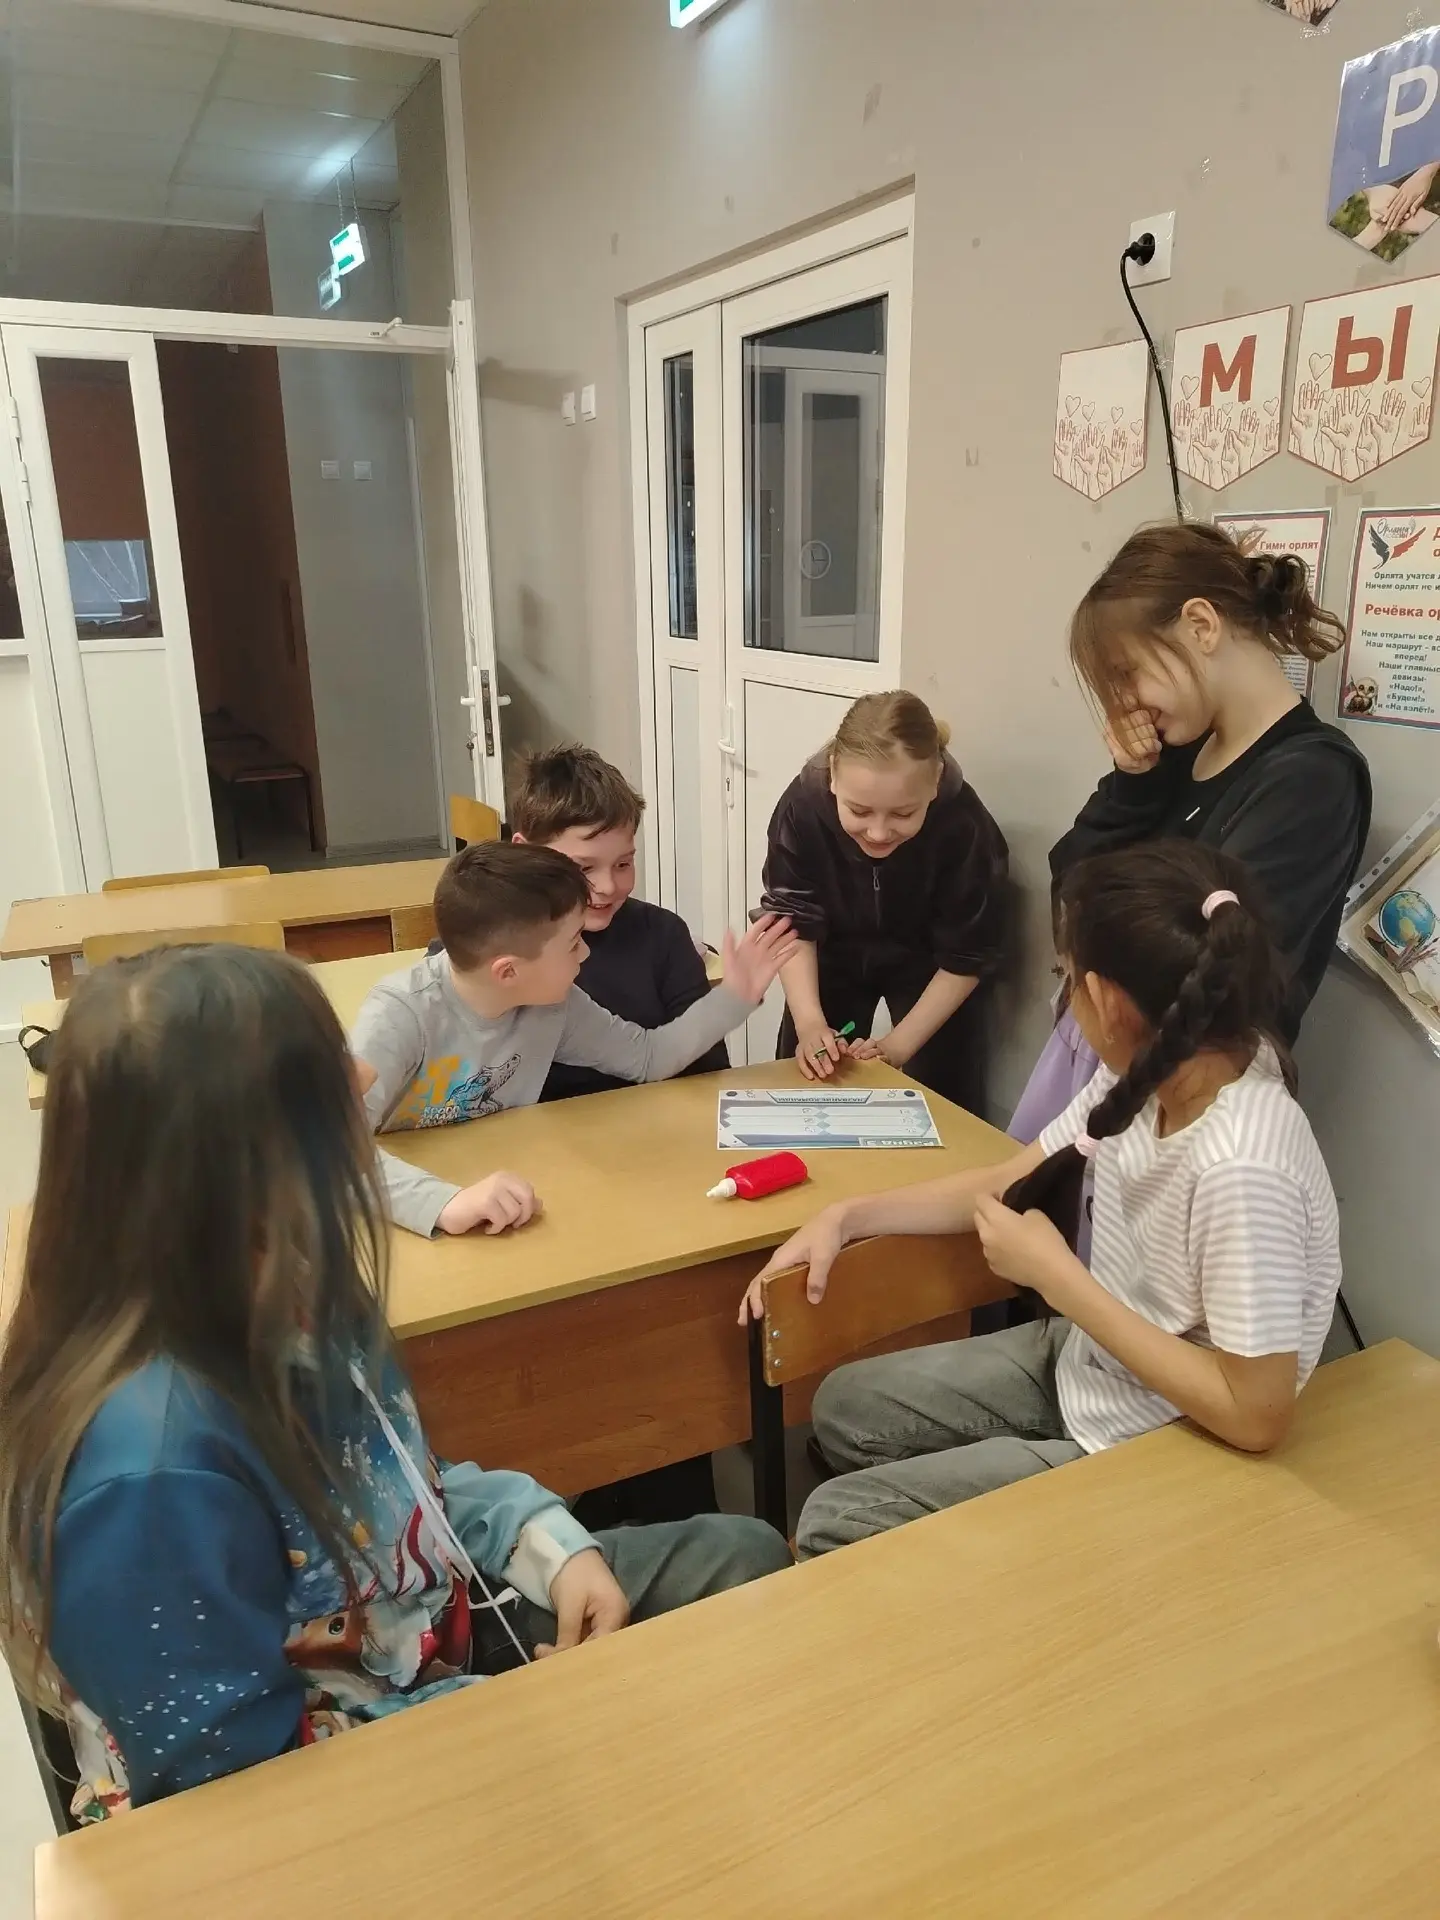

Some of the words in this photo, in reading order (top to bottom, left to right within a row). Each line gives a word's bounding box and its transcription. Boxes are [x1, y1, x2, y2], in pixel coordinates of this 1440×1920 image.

[1378, 64, 1438, 168] Р
[1260, 541, 1285, 550] Гимн
[1289, 541, 1319, 551] орлят
[1374, 571, 1404, 581] Орлята
[1406, 573, 1435, 581] учатся
[1365, 581, 1392, 590] Ничем
[1394, 583, 1419, 591] орлят
[1365, 603, 1423, 617] Речёвка
[1361, 629, 1378, 637] Нам
[1380, 631, 1416, 640] открыты
[1366, 640, 1383, 648] Наш
[1385, 643, 1422, 652] маршрут
[1379, 661, 1402, 670] Наши
